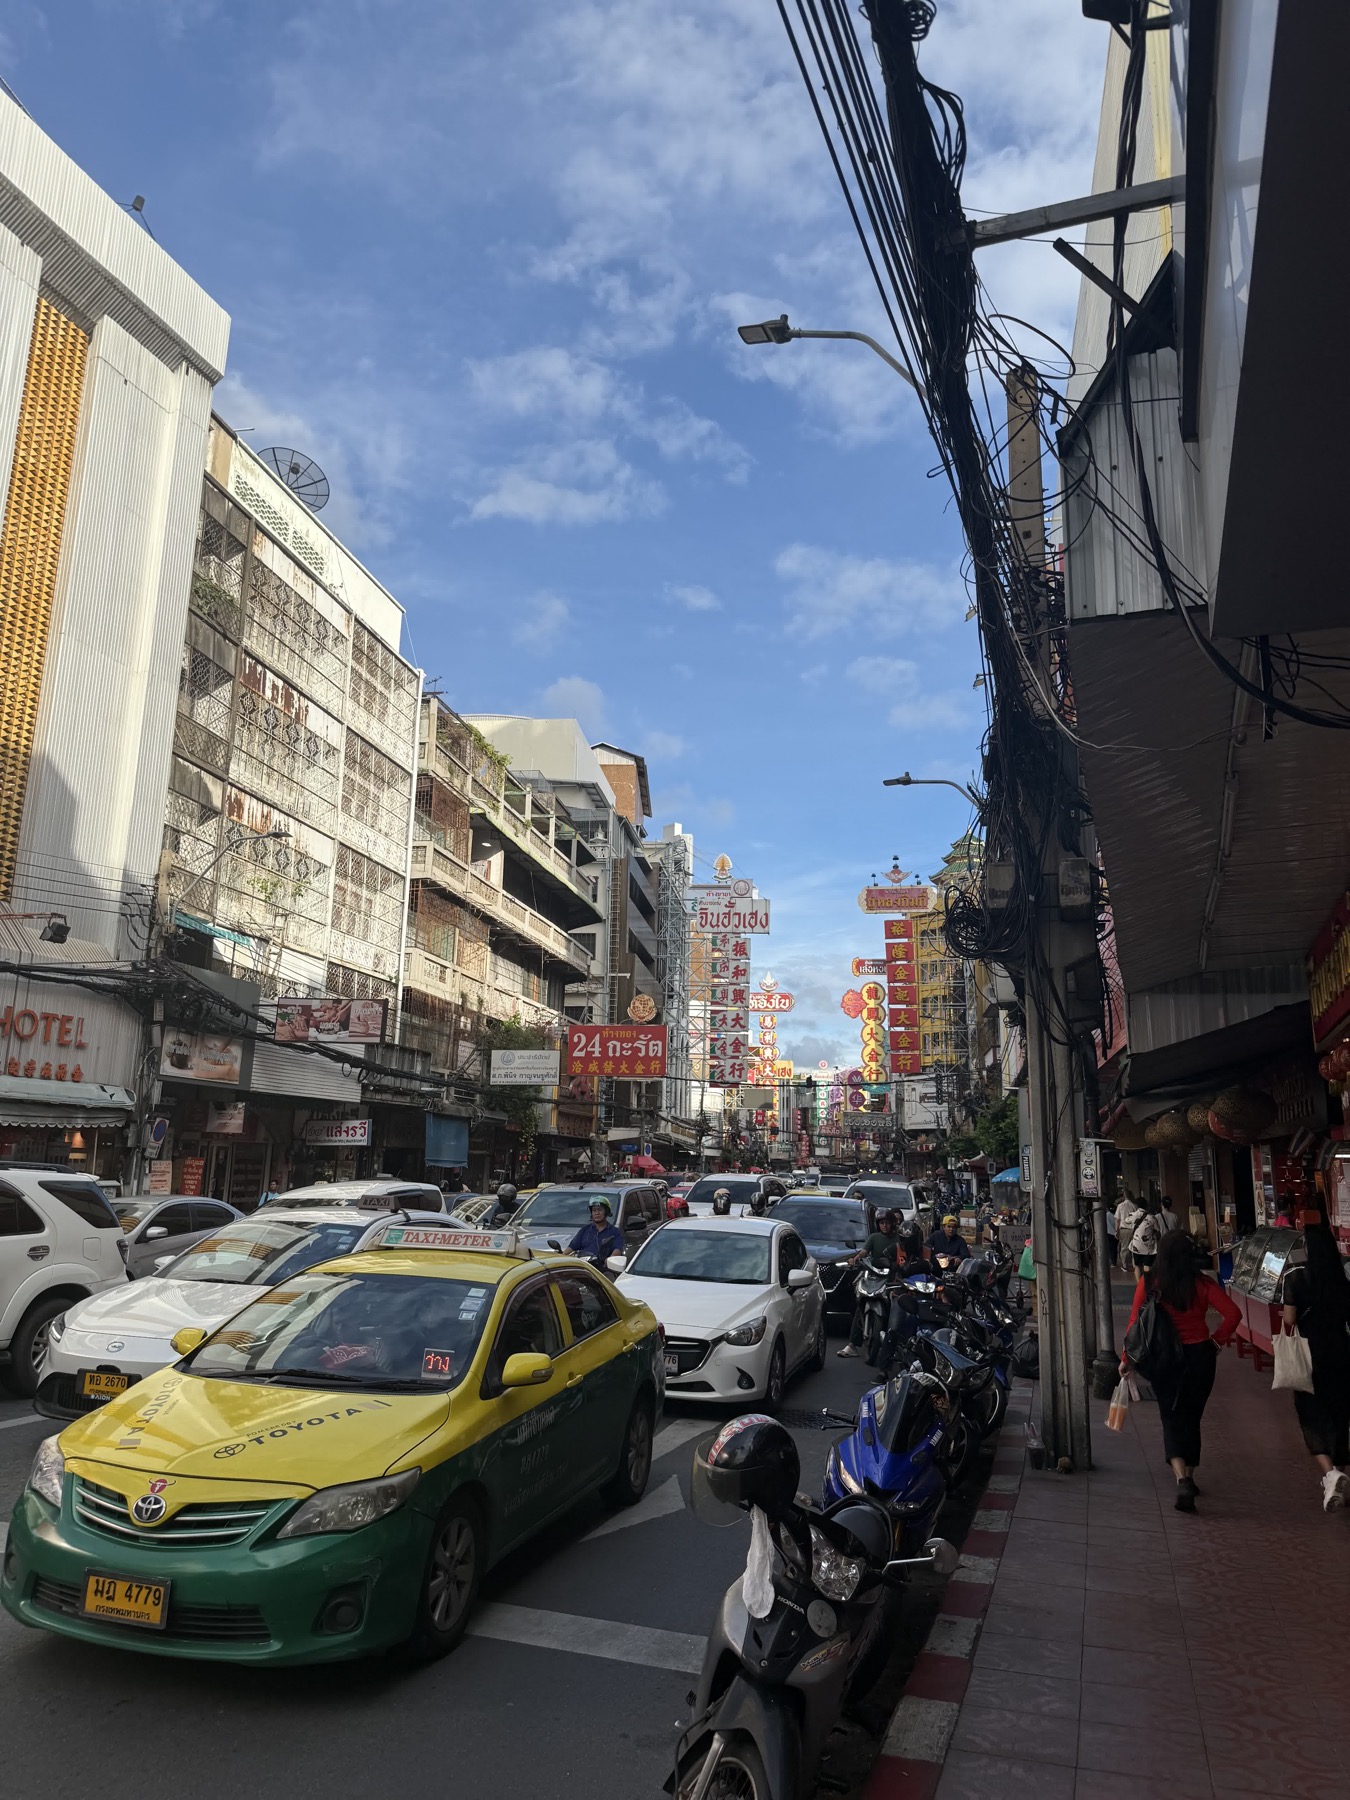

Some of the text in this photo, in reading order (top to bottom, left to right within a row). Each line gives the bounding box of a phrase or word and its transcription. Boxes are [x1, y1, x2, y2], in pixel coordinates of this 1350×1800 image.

[728, 940, 749, 1079] 振和興大金行
[572, 1033, 663, 1057] 24 กะรัต
[864, 986, 884, 1082] 龍鳳大金行
[403, 1231, 492, 1247] TAXI-METER
[425, 1353, 450, 1372] ว่าง
[105, 1376, 126, 1388] 2670
[126, 1388, 176, 1436] TOYOTA
[248, 1408, 363, 1445] TOYOTA
[124, 1583, 162, 1606] 4779
[776, 1595, 805, 1615] HONDA
